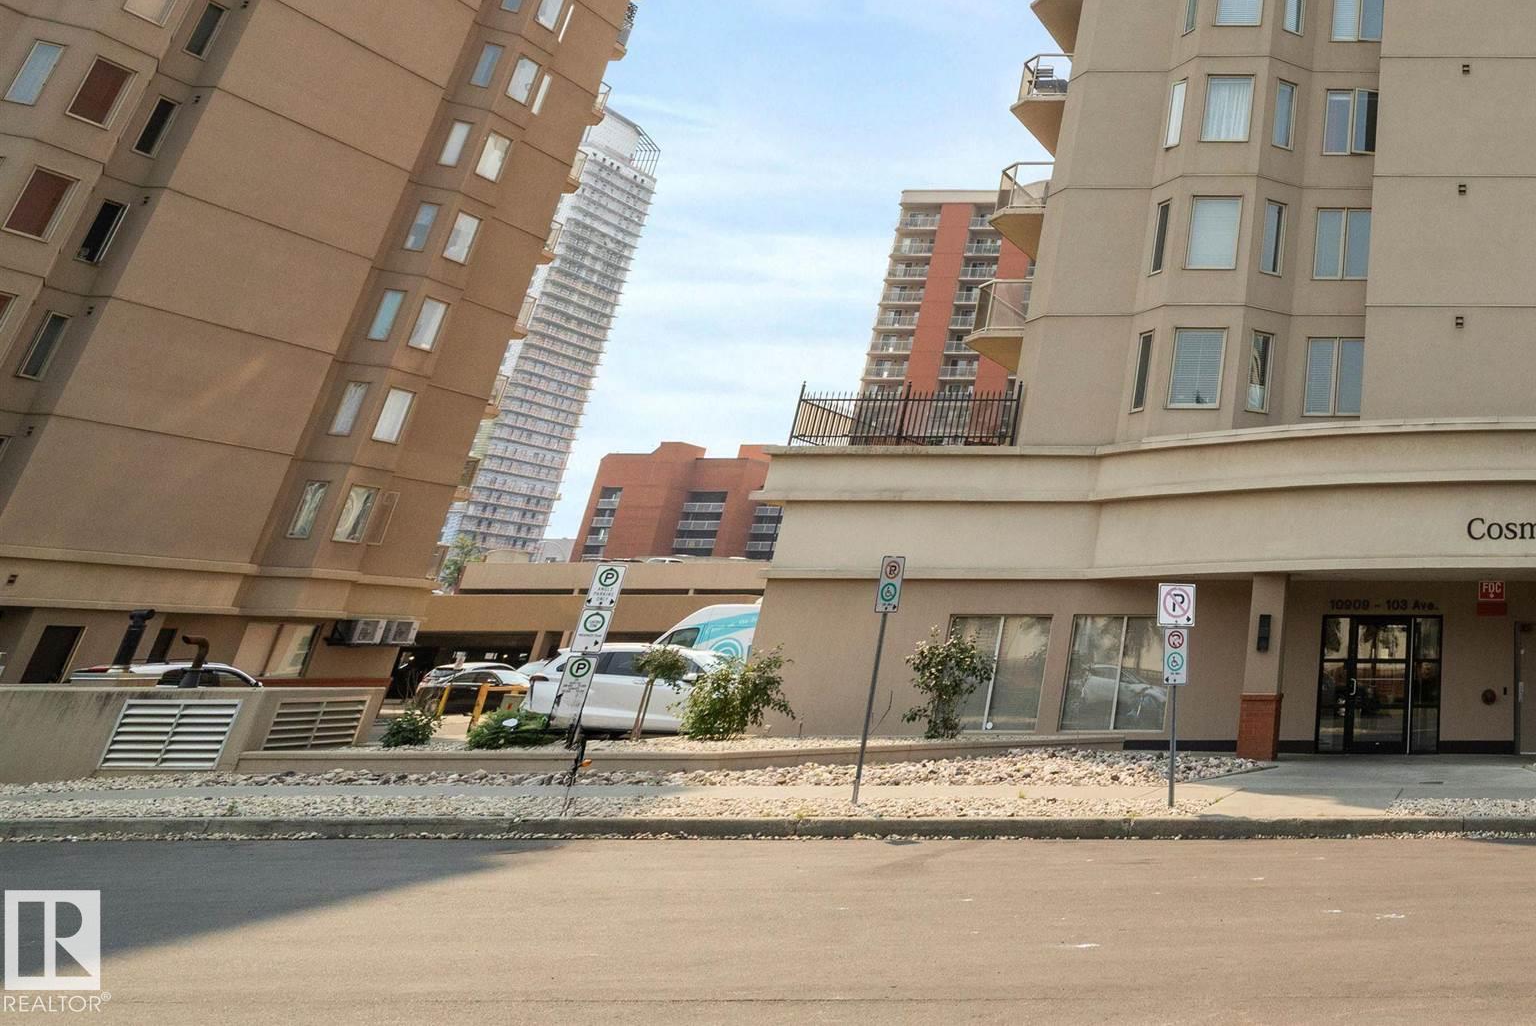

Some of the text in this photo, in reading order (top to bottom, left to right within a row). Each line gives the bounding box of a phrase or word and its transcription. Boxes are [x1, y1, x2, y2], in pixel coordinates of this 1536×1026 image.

[604, 572, 615, 583] P
[1482, 581, 1502, 593] FDC
[1329, 599, 1370, 611] 10909
[1385, 599, 1408, 611] 103
[575, 662, 587, 674] P
